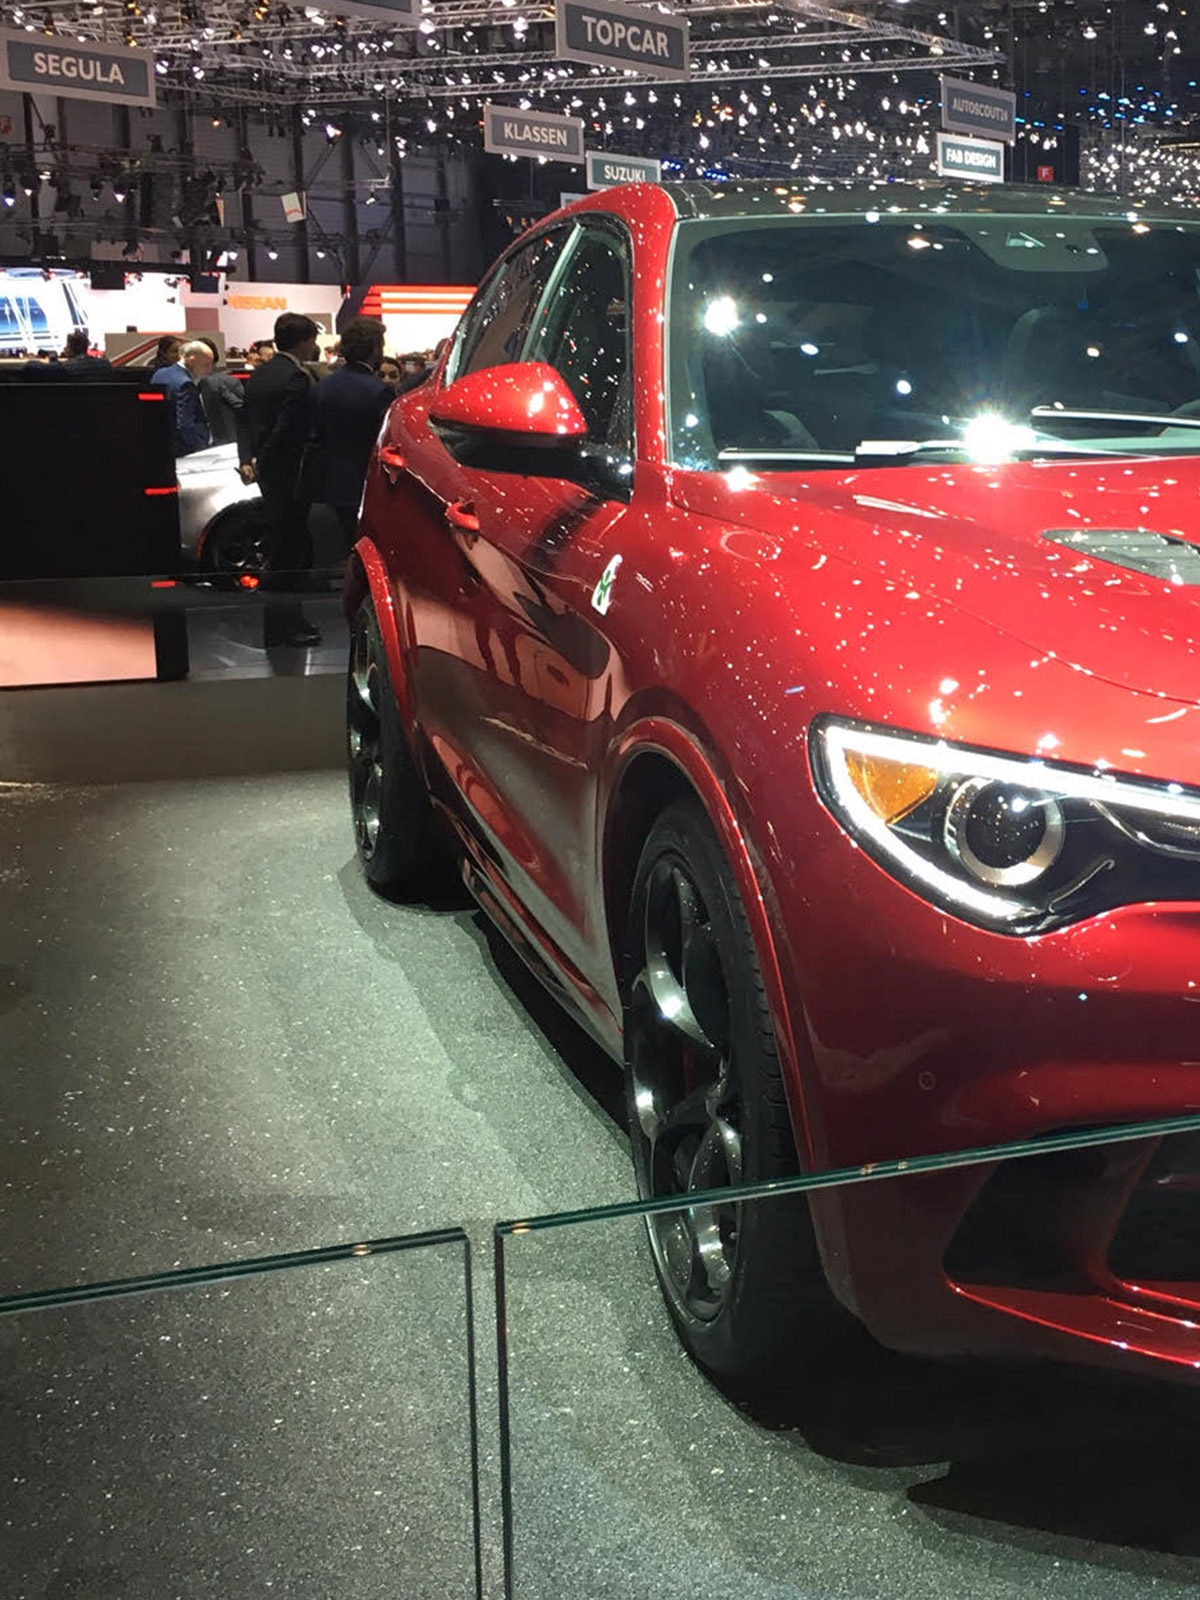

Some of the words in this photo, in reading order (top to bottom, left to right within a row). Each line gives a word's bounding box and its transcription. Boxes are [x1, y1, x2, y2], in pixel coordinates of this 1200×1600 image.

[582, 15, 670, 58] TOPCAR
[34, 52, 125, 85] SEGULA
[503, 121, 568, 147] KLASSEN
[946, 148, 963, 164] FAB
[964, 151, 996, 168] DESIGN
[604, 164, 646, 183] SUZUKI
